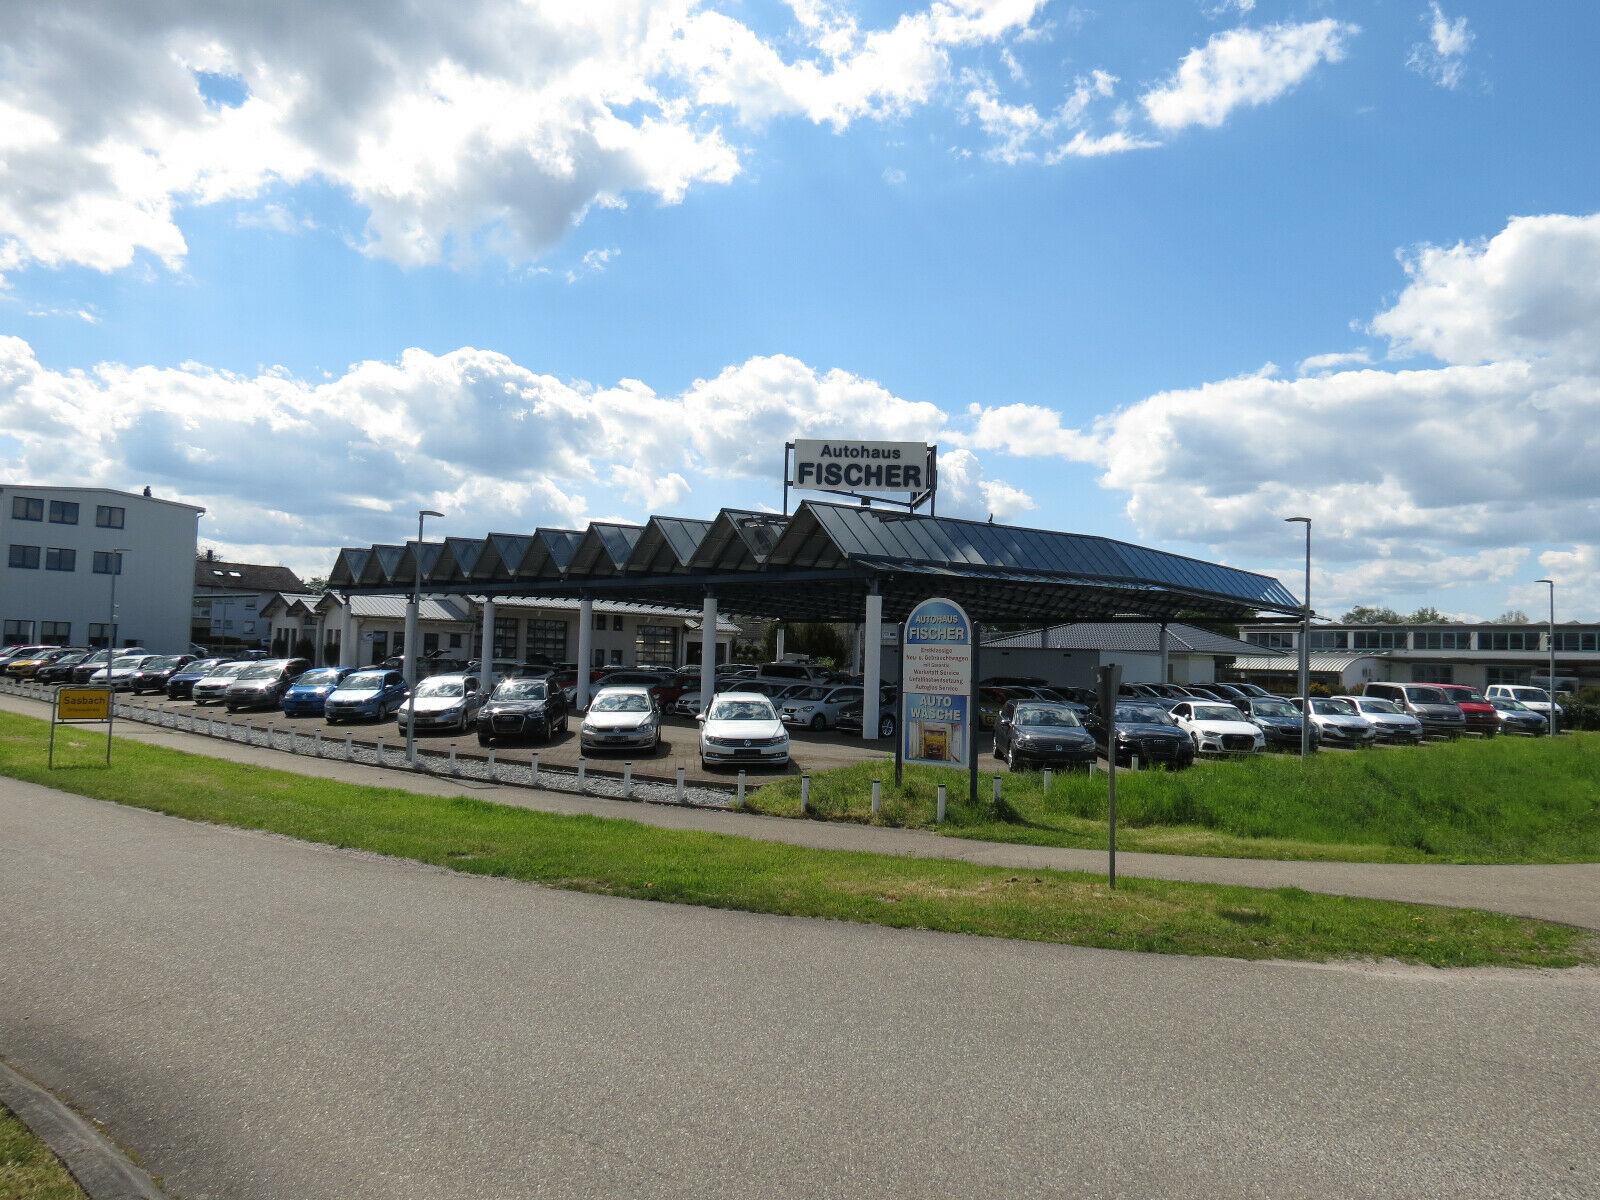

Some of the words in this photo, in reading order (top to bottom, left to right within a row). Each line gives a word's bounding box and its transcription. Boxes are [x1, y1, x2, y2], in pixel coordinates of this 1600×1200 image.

[821, 445, 901, 459] Autohaus
[798, 463, 922, 487] FISCHER
[915, 615, 958, 624] AUTOHAUS
[909, 627, 964, 640] FISCHER
[64, 696, 106, 704] Sasbach
[920, 696, 952, 707] AUTO
